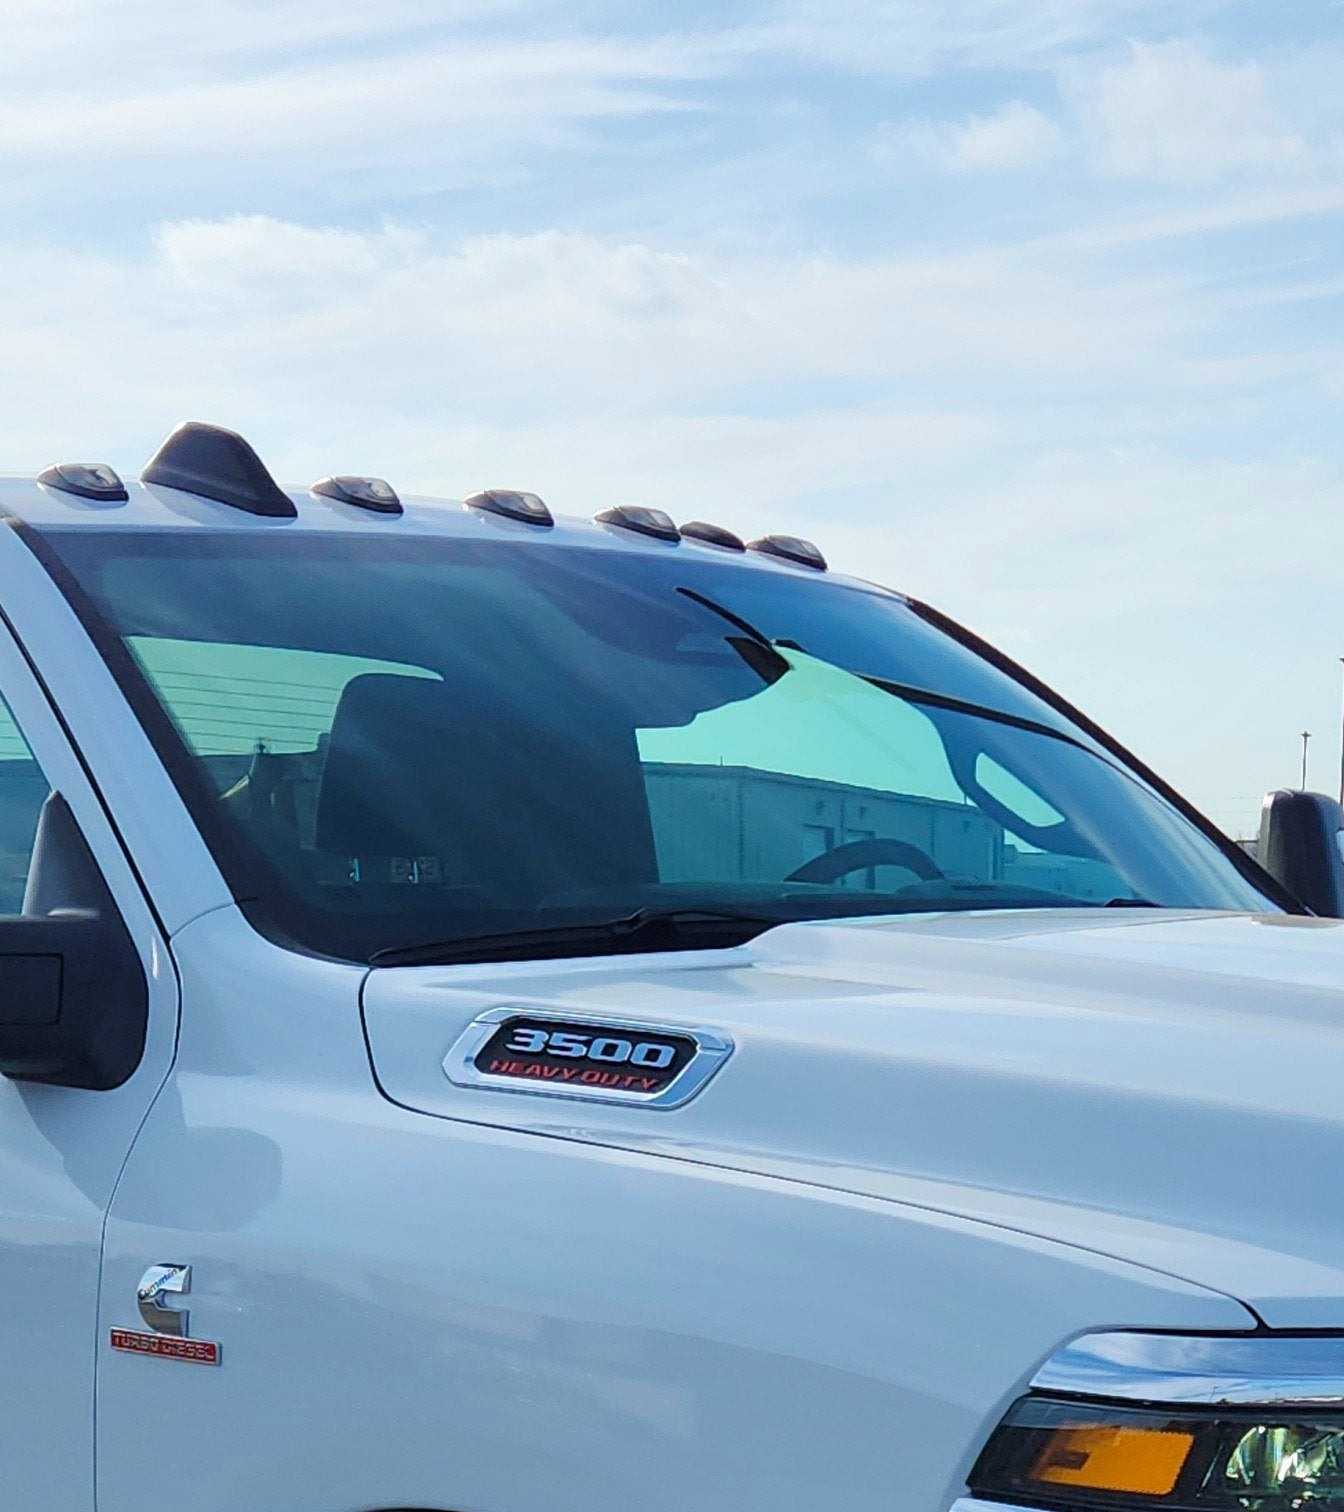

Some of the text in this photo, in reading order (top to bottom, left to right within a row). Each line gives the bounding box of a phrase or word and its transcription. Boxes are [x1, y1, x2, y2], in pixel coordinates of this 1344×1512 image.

[505, 1027, 677, 1069] 3500
[490, 1059, 660, 1091] HEAVY DUTY
[112, 1331, 215, 1360] TURBO DIESEL
